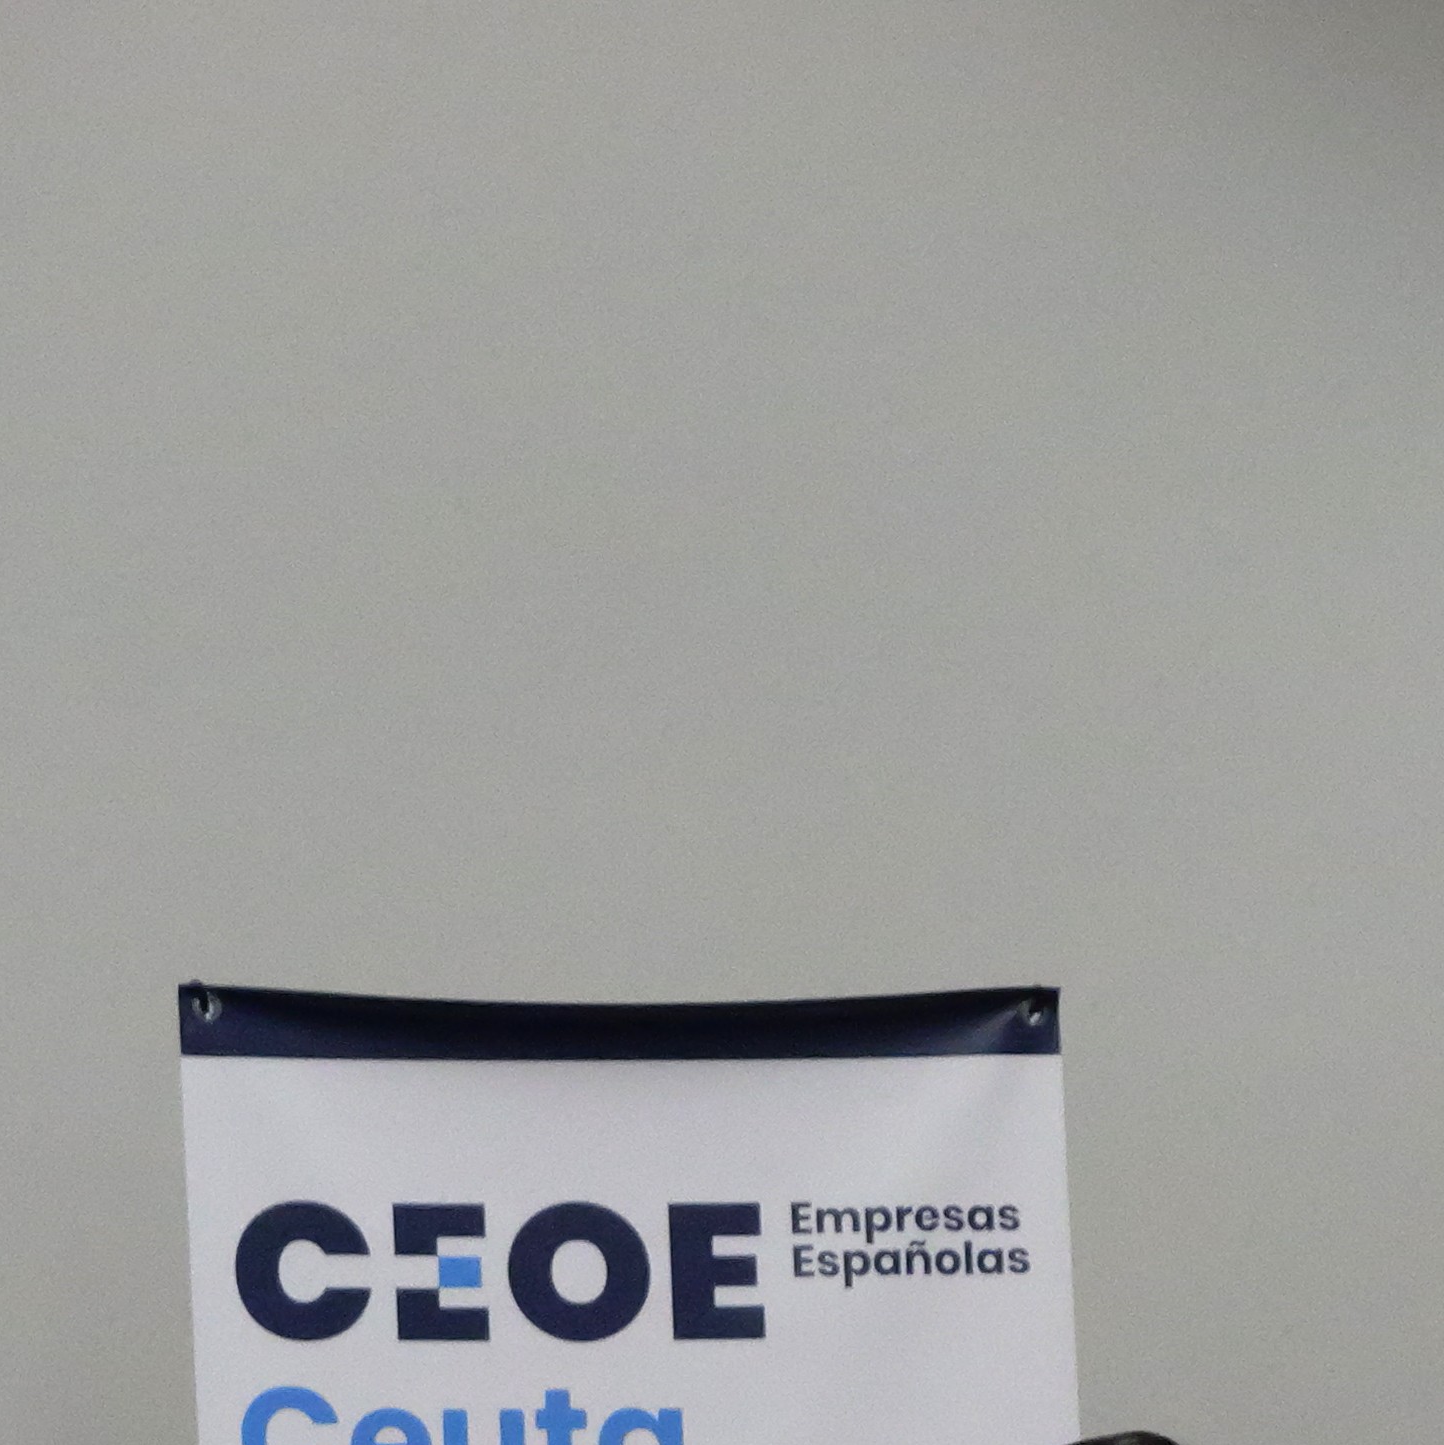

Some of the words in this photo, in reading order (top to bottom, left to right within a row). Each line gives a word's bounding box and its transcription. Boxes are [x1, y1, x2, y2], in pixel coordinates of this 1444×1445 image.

[235, 1200, 766, 1342] CEOE
[790, 1201, 1021, 1242] Empresas
[792, 1239, 1032, 1289] Españolas
